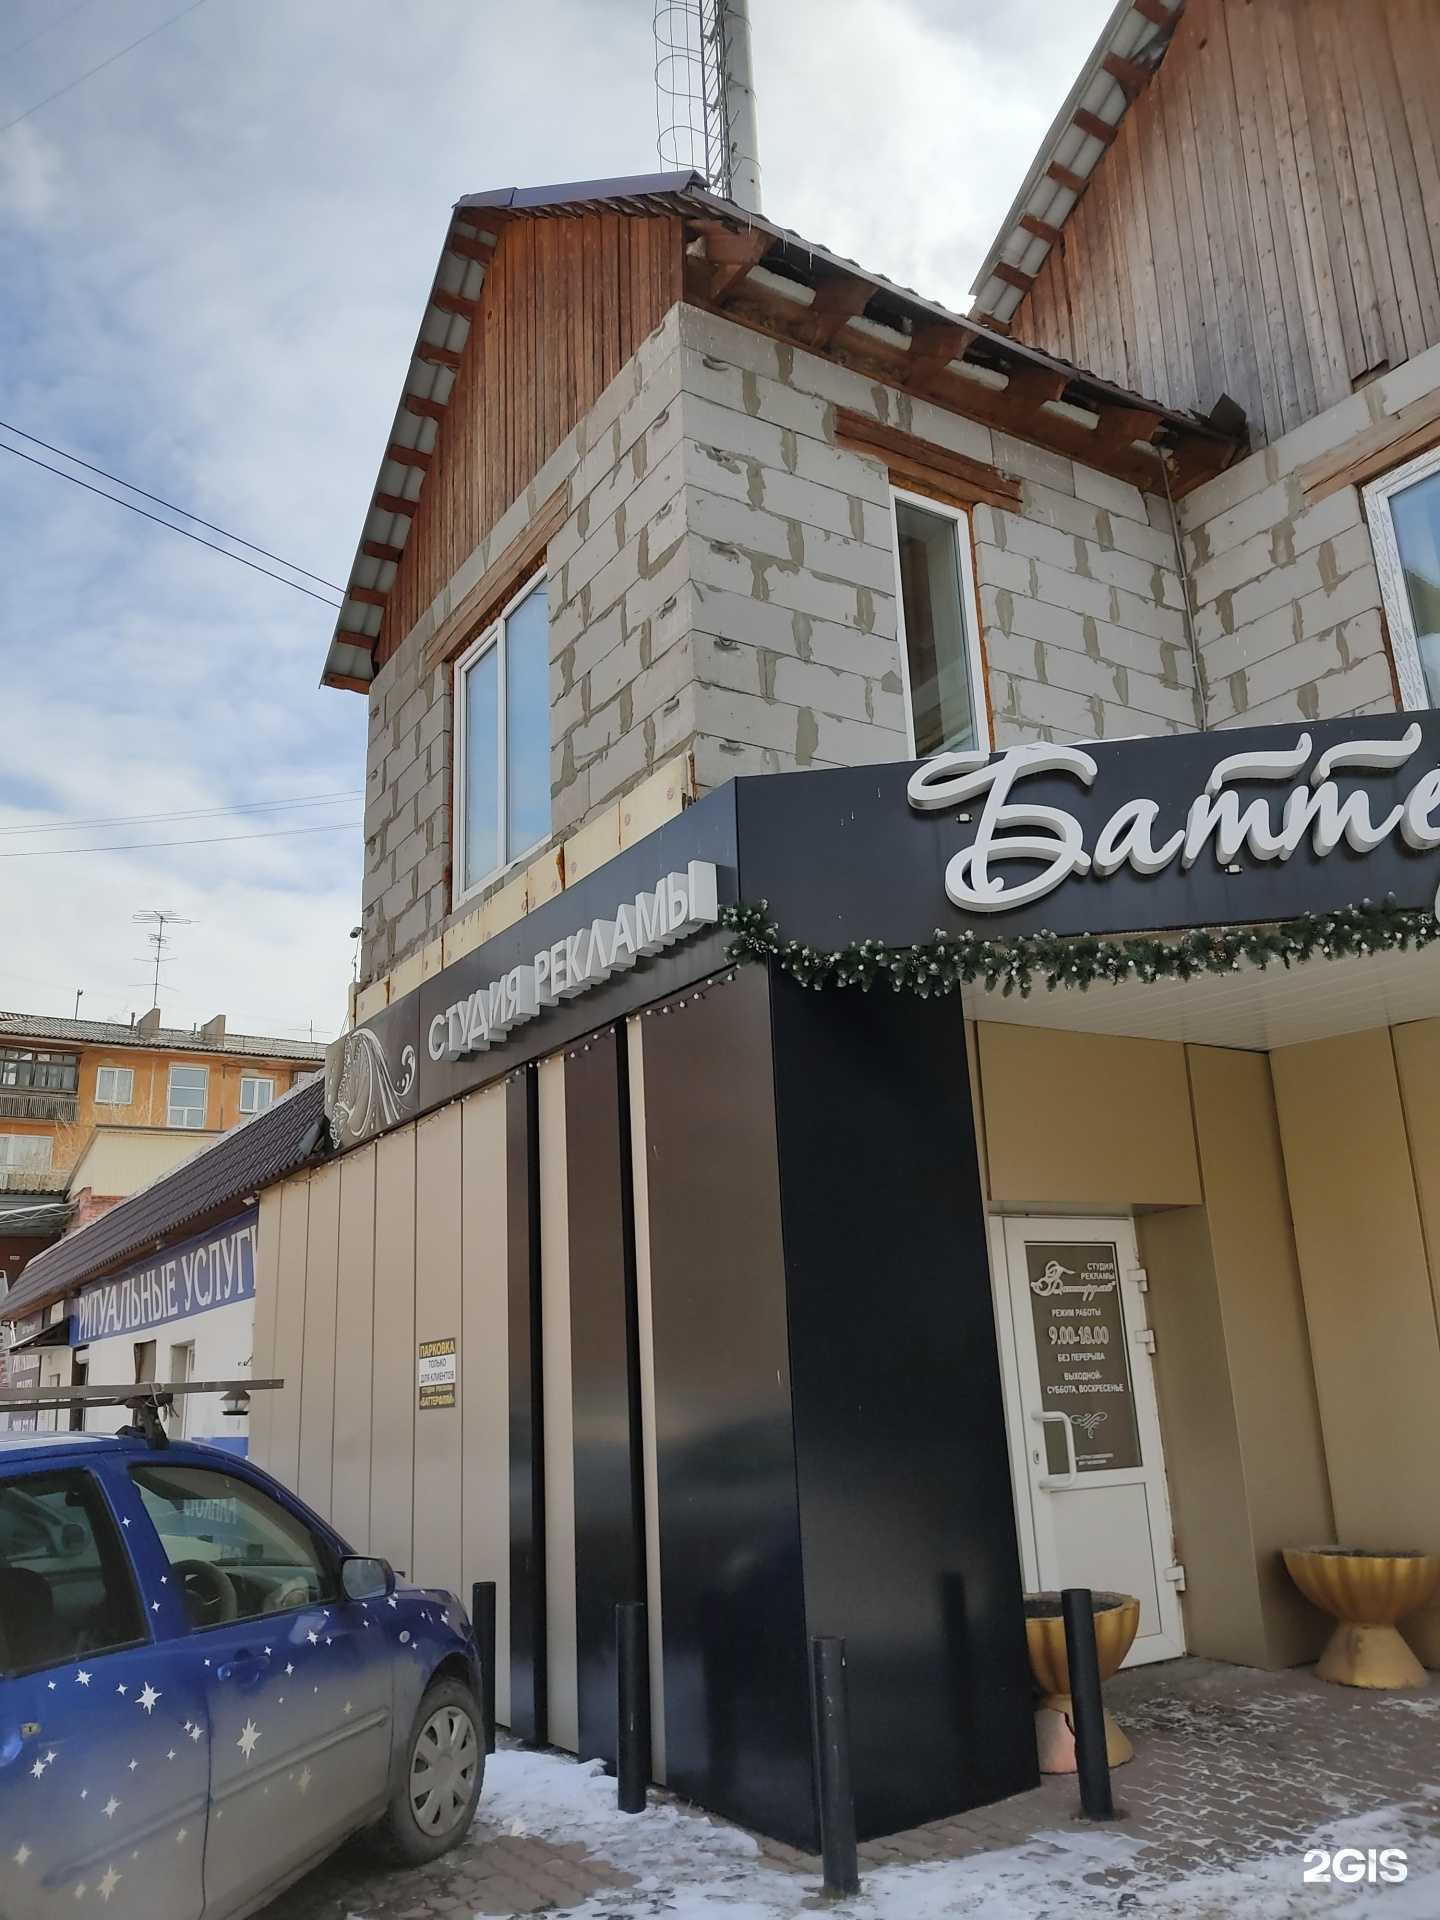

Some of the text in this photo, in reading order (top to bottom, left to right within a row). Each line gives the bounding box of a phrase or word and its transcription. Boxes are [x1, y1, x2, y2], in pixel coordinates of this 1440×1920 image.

[428, 860, 718, 1062] СТУДИЯ РЕКЛАМЫ
[78, 1260, 179, 1341] РИТУАЛЬНЫЕ
[420, 1339, 455, 1358] ПАРКОВКА
[1057, 1353, 1070, 1362] БЕЗ
[1078, 1383, 1125, 1393] ВОСКРЕСЕНЬЕ
